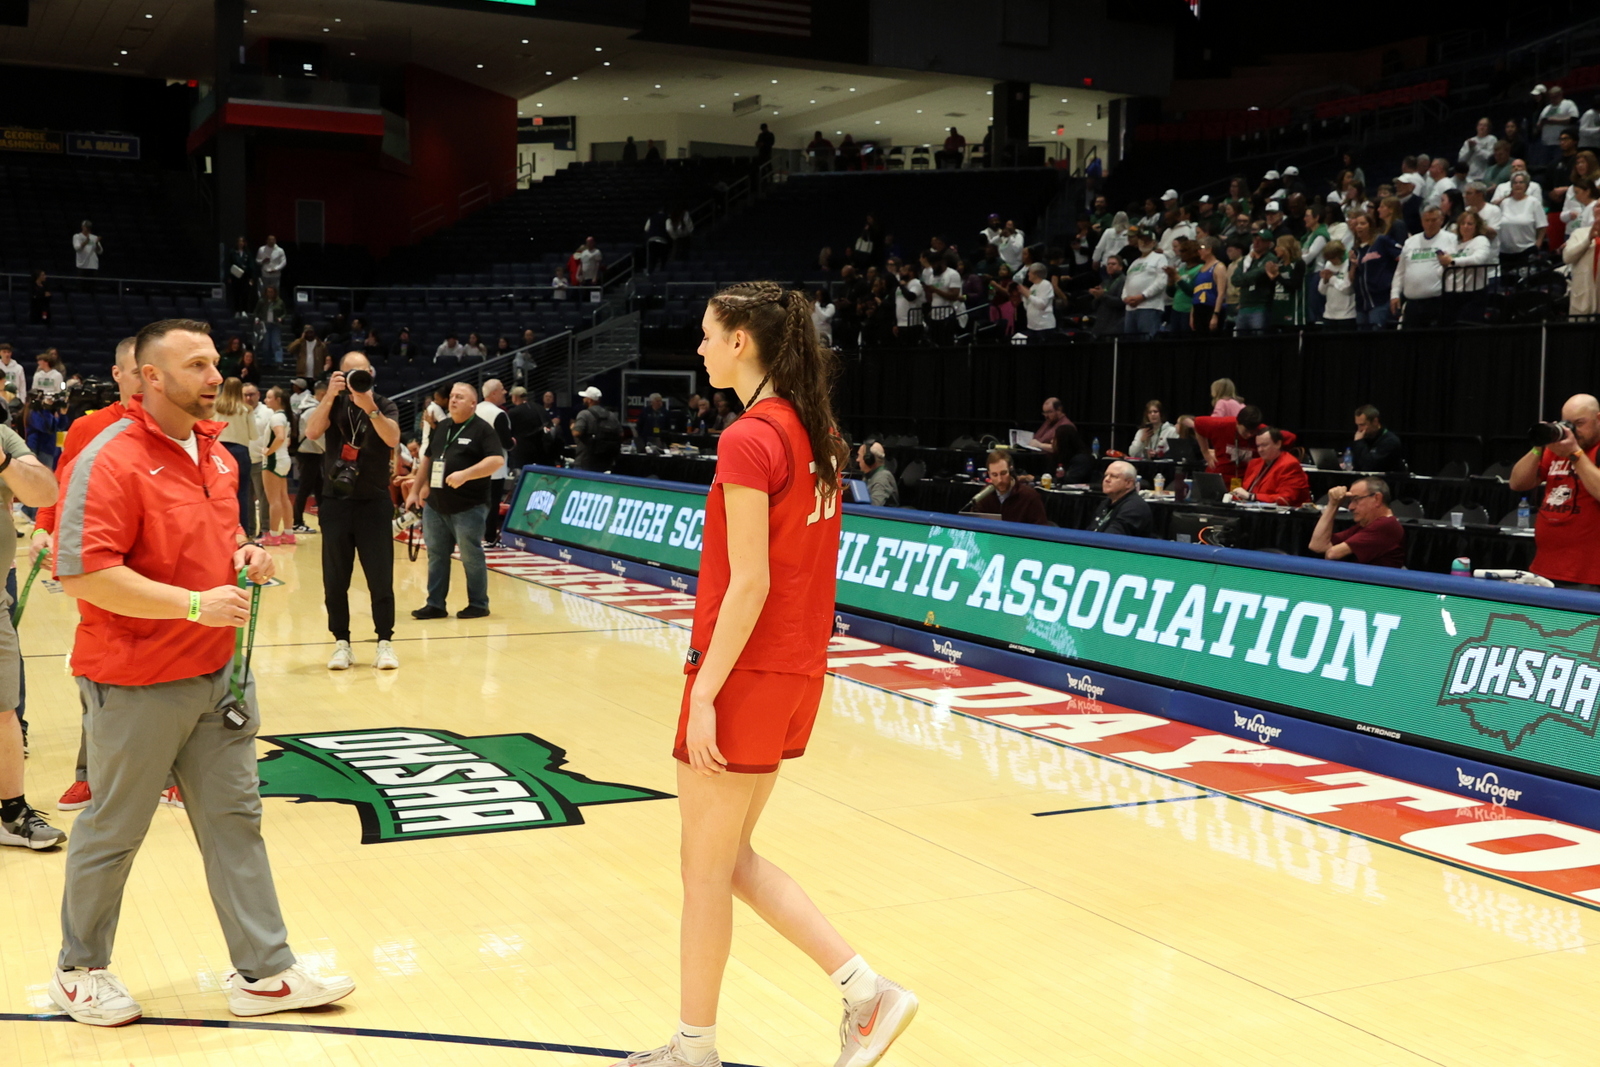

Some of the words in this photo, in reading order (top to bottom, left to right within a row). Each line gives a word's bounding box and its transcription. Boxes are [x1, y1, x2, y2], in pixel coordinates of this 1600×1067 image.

[4, 131, 46, 141] GEORGE
[77, 140, 93, 150] LA
[561, 490, 614, 531] OHIO
[608, 498, 674, 543] HIGH
[668, 507, 706, 551] SC
[966, 553, 1401, 687] ASSOCIATION
[941, 641, 962, 663] Kroger
[1078, 675, 1105, 700] Kroger
[1449, 646, 1600, 721] OHSAA
[1246, 714, 1282, 743] Kroger
[1356, 724, 1401, 739] DAKTRONICS
[299, 732, 546, 833] OHSAA
[898, 681, 1600, 903] DAYTO
[1475, 772, 1522, 806] Kroger
